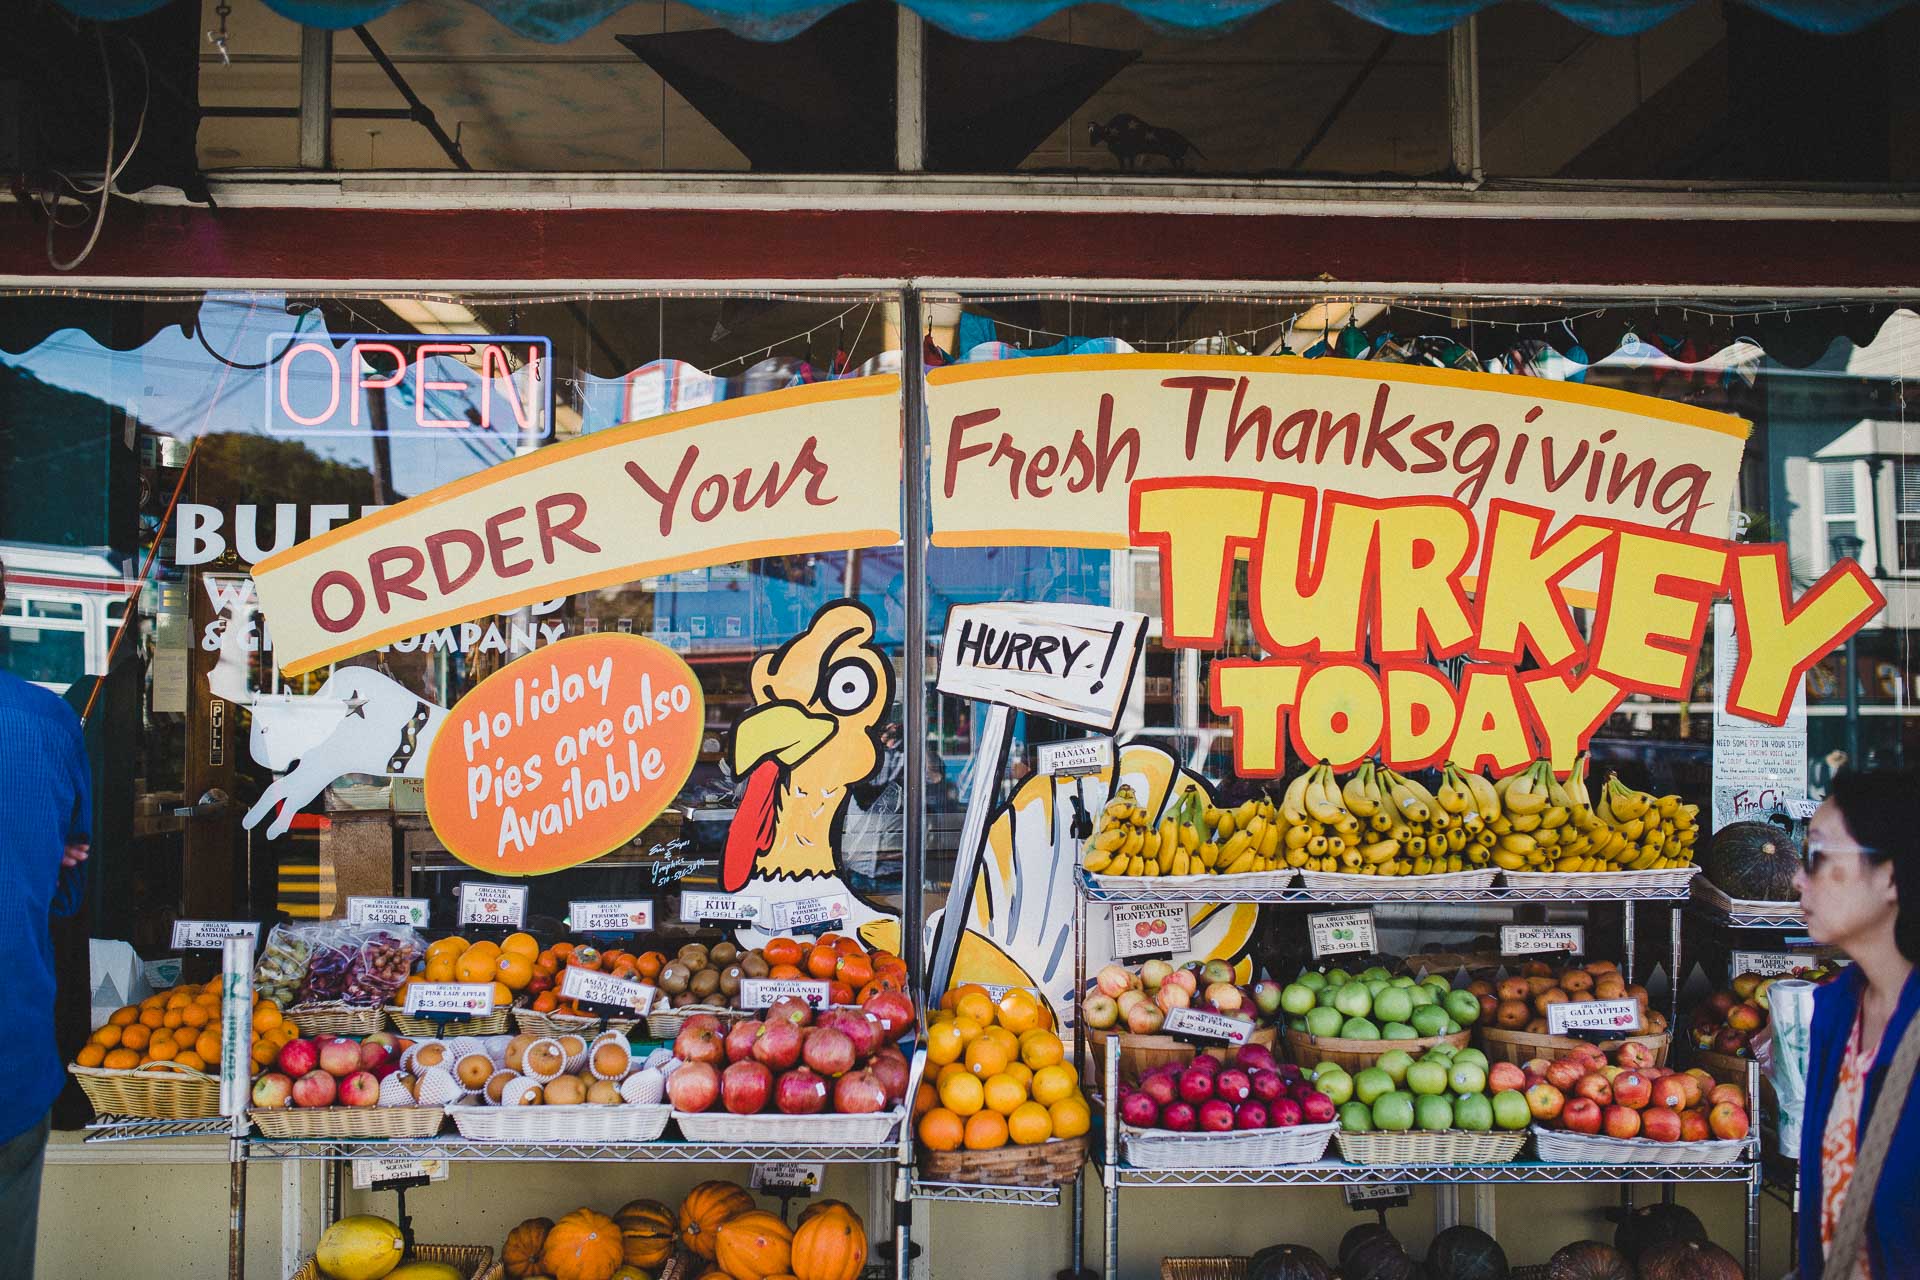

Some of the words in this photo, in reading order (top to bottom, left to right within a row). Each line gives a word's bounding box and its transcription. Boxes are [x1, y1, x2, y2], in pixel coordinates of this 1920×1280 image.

[279, 343, 538, 428] OPEN
[943, 393, 1140, 500] Fresh
[1160, 375, 1716, 531] Thanksgiving
[311, 492, 601, 633] ORDER
[624, 435, 838, 537] Your
[1130, 477, 1887, 727] TURKEY
[463, 657, 613, 762] Holiday
[554, 718, 615, 767] are
[623, 672, 691, 735] also
[1210, 657, 1628, 779] TODAY
[212, 705, 222, 750] PULL
[1761, 740, 1769, 748] IN
[1770, 740, 1786, 748] YOUR
[1054, 747, 1097, 759] BANANAS
[1051, 756, 1098, 769] $1.69LB
[498, 739, 666, 858] Available
[706, 900, 737, 911] KIWI
[1131, 903, 1167, 912] ORGANIC
[470, 913, 510, 924] $3.29LB
[790, 911, 829, 925] $4.99LB
[1116, 908, 1184, 921] HONEYCRISP
[589, 919, 630, 929] $4.99LB
[1132, 937, 1170, 949] $3.99LB
[1320, 941, 1371, 952] $3.99LB
[759, 986, 823, 994] POMEGRANATE
[1570, 1008, 1594, 1017] GALA
[1597, 1006, 1631, 1015] APPLES
[1561, 1016, 1618, 1029] $3.99LB
